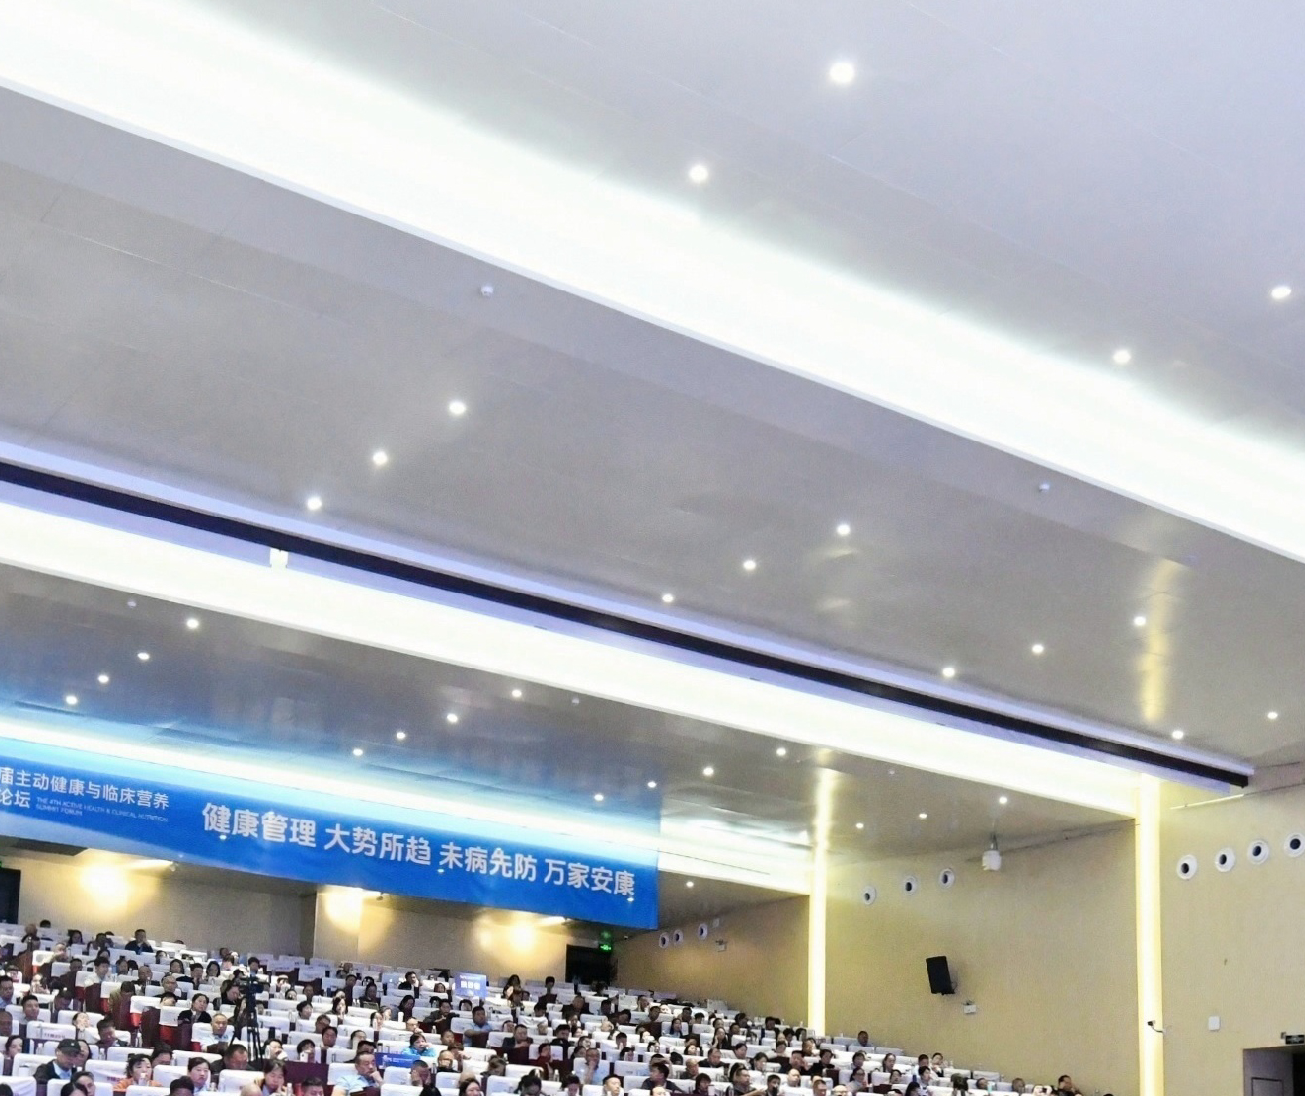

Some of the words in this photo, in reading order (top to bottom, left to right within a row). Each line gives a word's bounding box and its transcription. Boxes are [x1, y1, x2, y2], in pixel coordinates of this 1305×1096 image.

[61, 807, 83, 816] FORUM
[202, 802, 317, 848] 健康管理
[324, 823, 431, 866] 大势所趋
[440, 841, 537, 883] 未病先防
[544, 857, 635, 897] 万家安康
